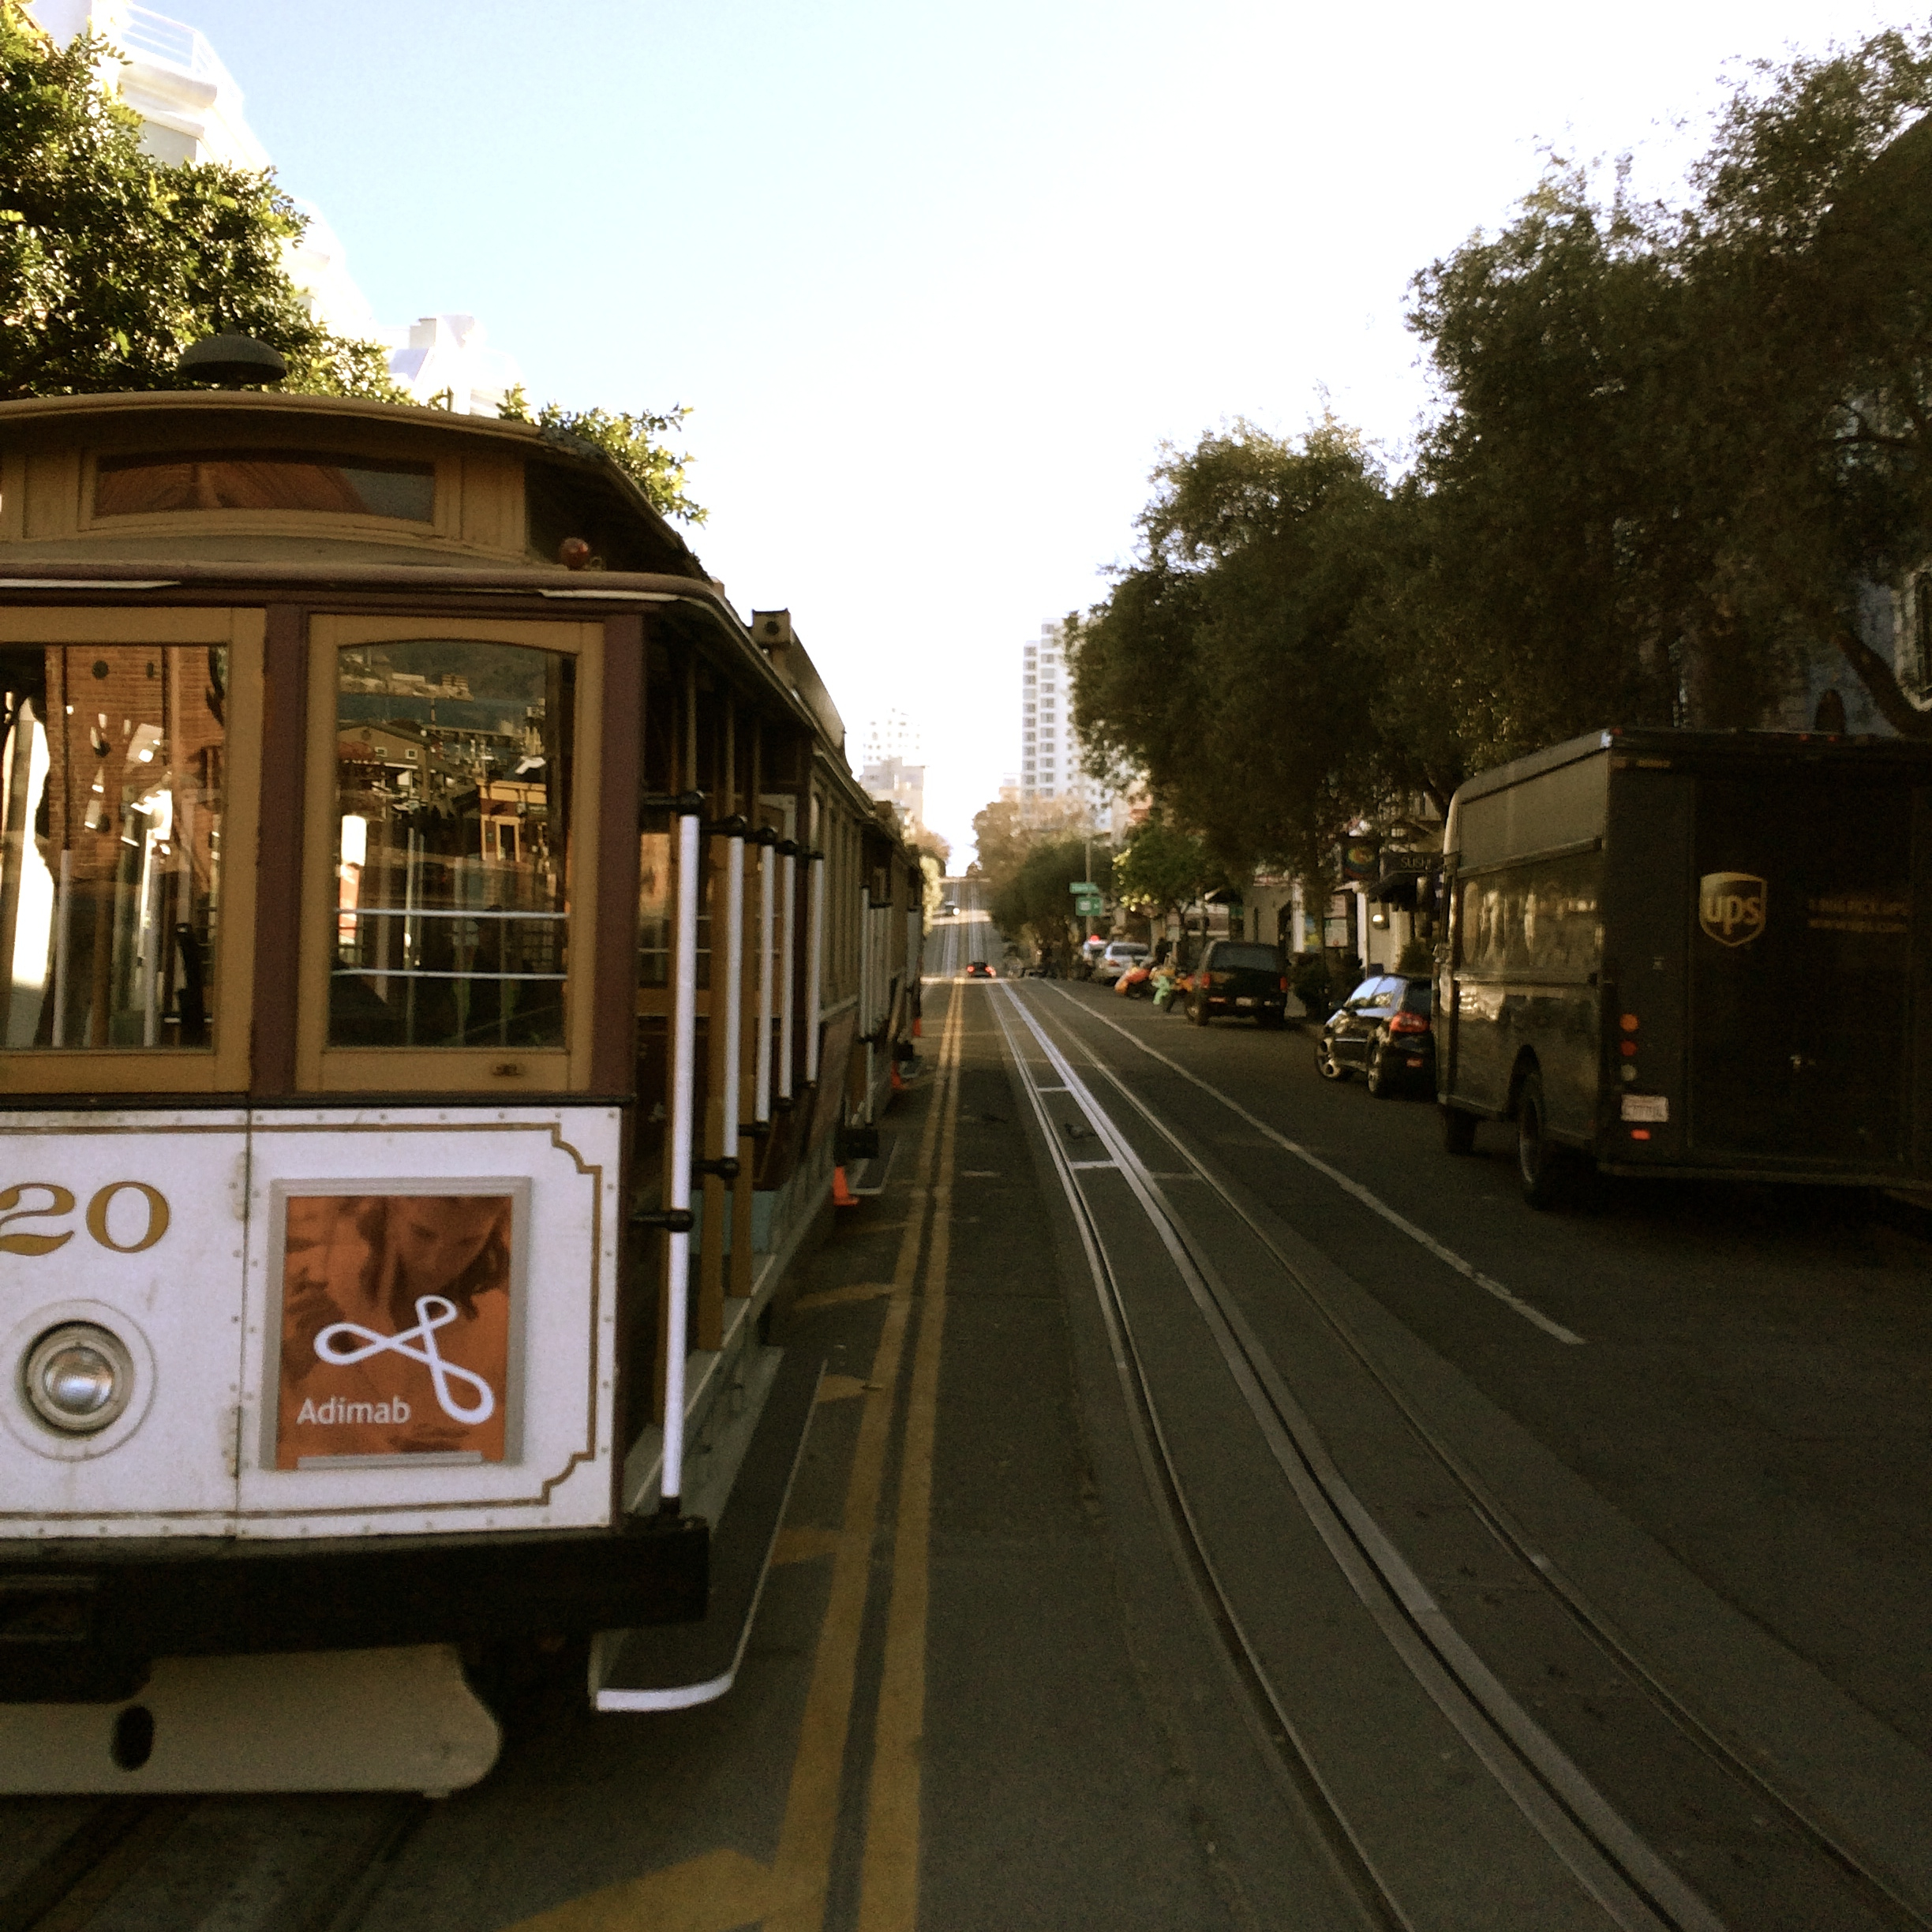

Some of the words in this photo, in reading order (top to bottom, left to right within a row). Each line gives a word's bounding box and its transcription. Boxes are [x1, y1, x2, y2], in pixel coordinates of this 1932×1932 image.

[1705, 895, 1761, 935] ups
[0, 1181, 170, 1256] 20
[297, 1396, 411, 1425] Adimab
